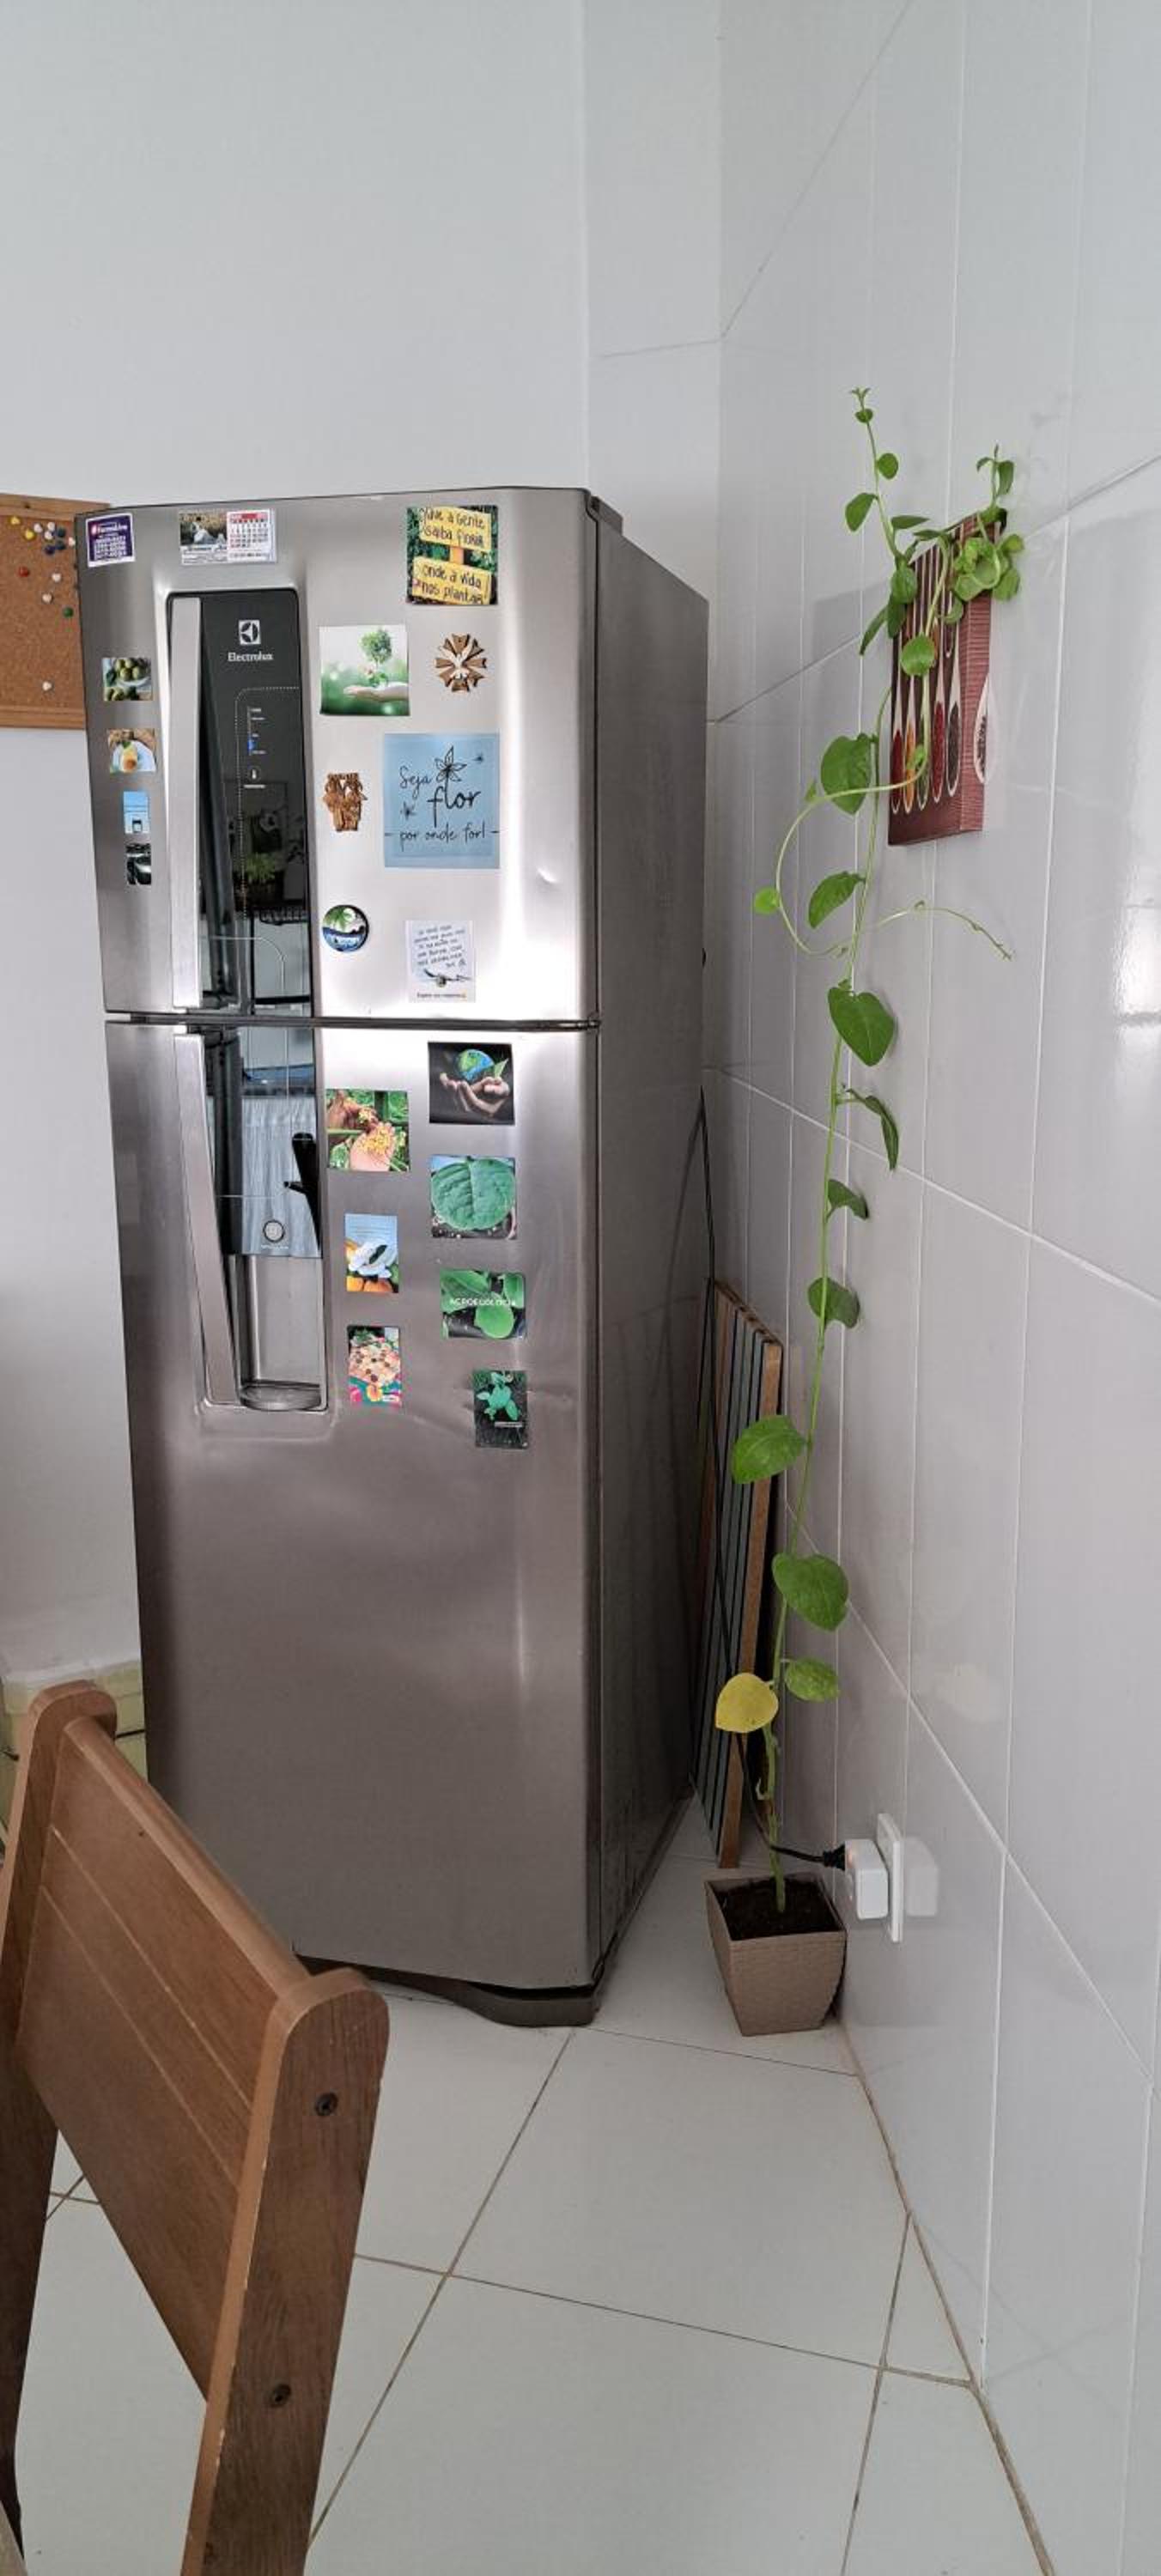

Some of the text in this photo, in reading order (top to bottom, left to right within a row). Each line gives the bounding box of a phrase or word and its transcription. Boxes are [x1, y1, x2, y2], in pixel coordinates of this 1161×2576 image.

[228, 651, 275, 662] Electrolux
[399, 765, 431, 799] Seja
[427, 775, 482, 829] flor
[399, 830, 417, 853] por
[425, 822, 458, 843] onde
